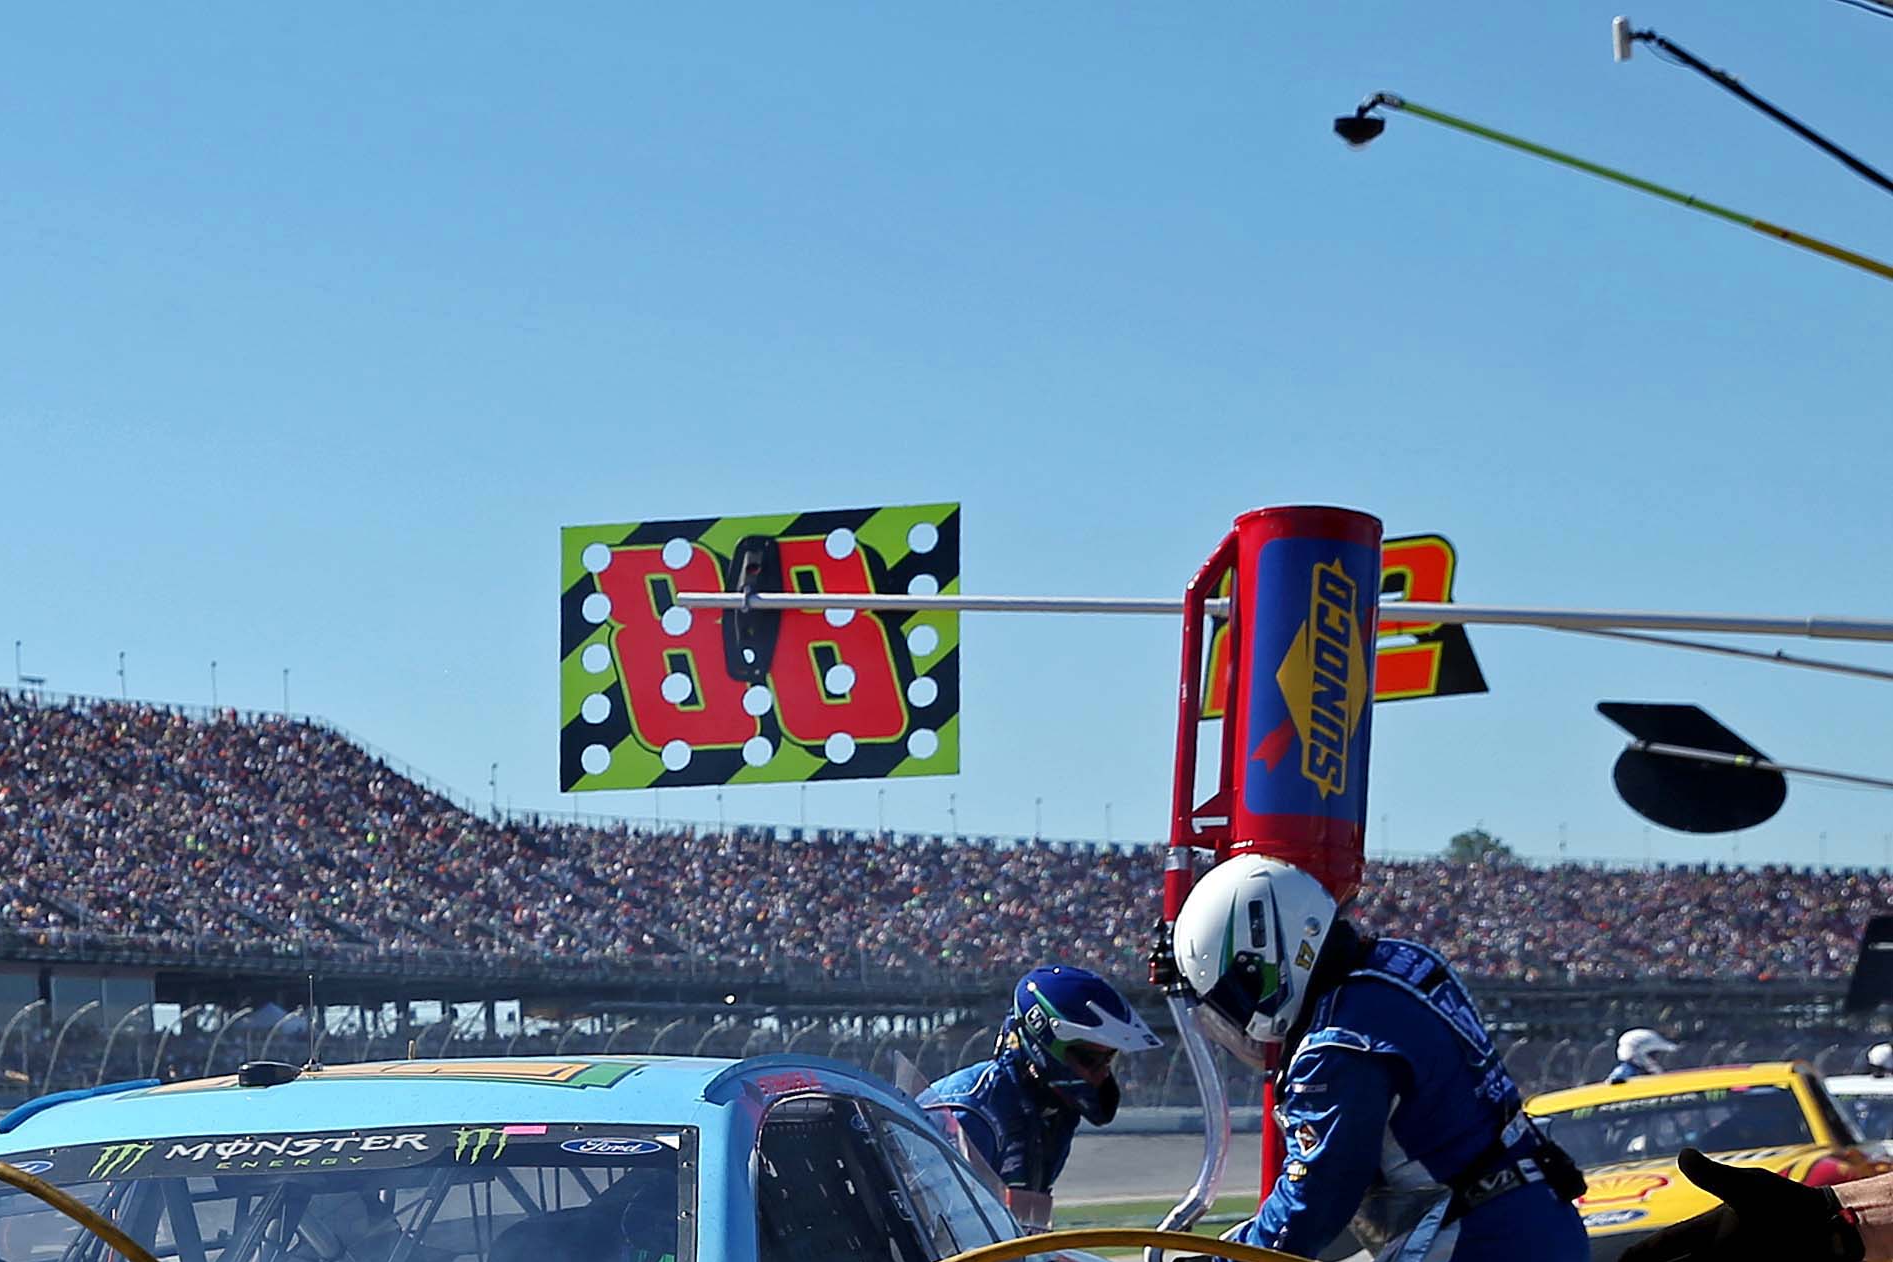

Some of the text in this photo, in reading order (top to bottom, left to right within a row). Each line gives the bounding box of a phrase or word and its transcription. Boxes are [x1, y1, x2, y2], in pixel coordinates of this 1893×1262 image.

[595, 534, 907, 752] 88
[1308, 571, 1355, 788] SUNOCO
[216, 1155, 364, 1170] ENERGY
[571, 1138, 651, 1154] Ford
